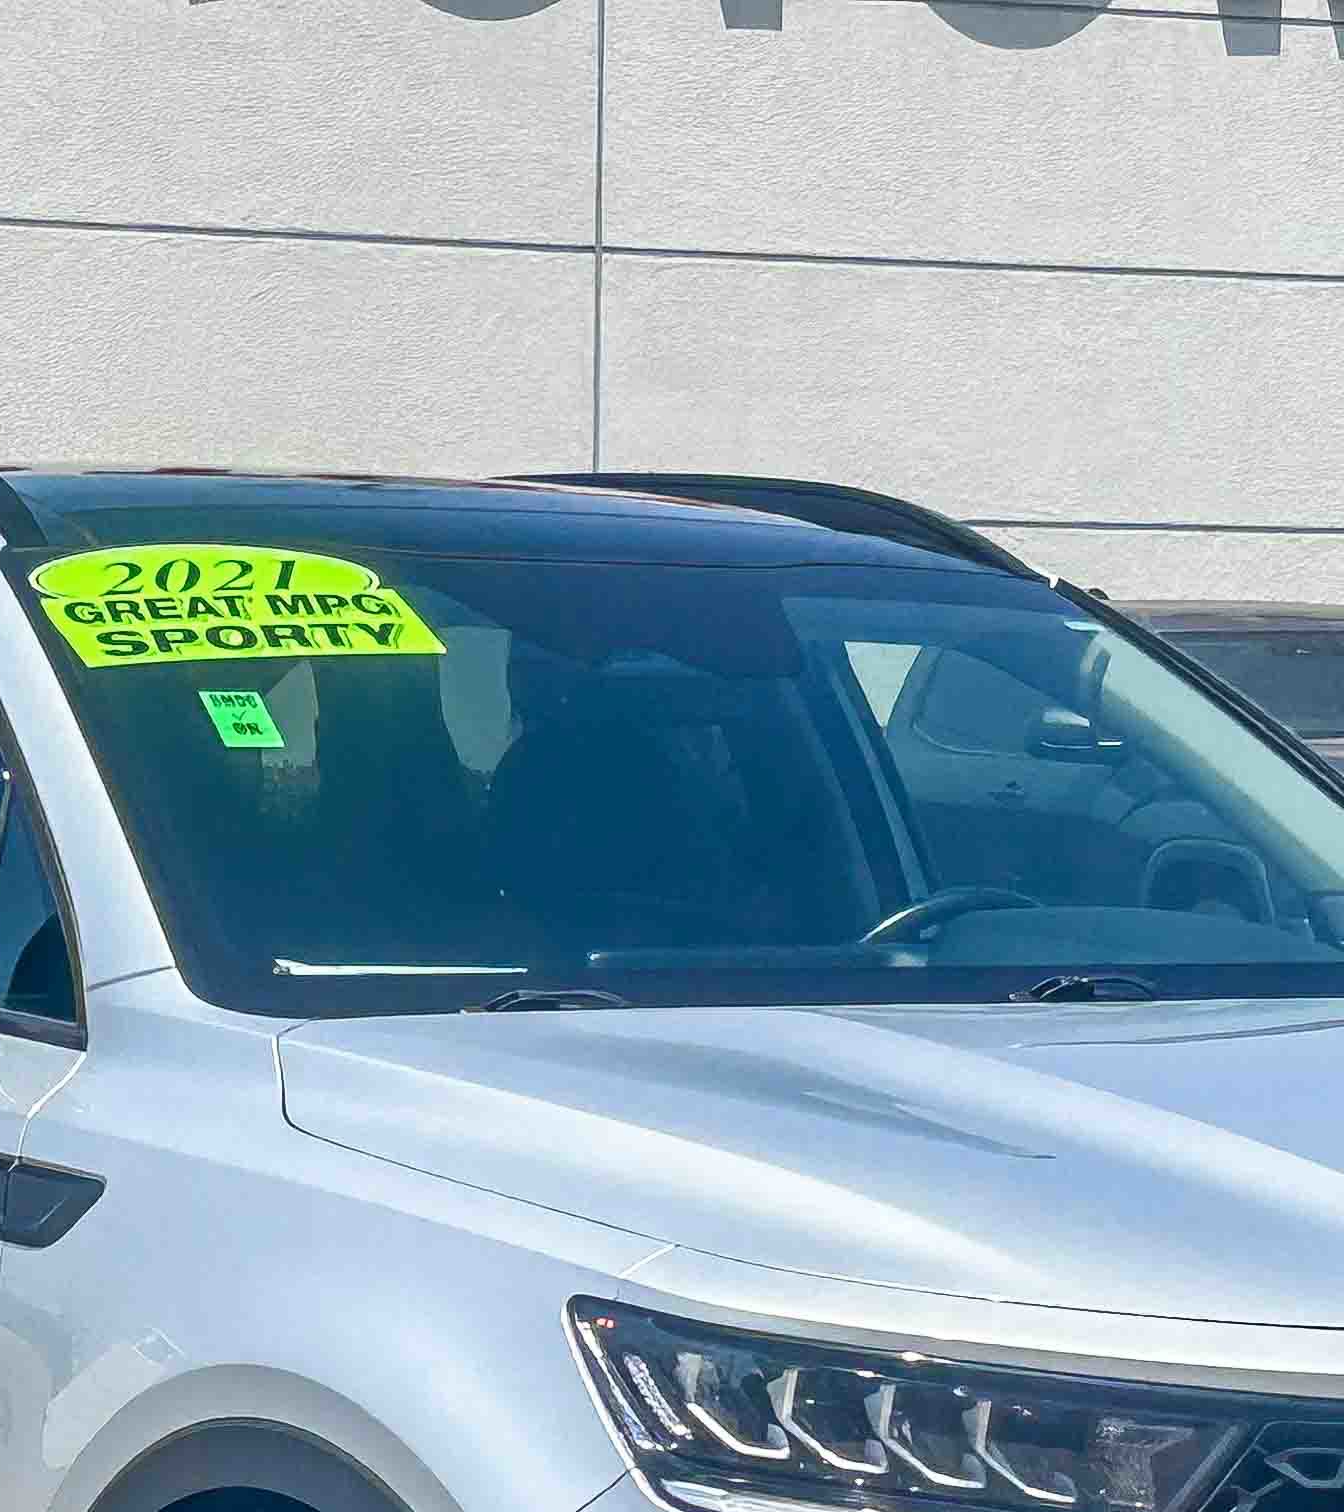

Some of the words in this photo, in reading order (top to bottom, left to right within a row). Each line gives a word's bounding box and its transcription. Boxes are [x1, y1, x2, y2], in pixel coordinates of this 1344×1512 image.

[99, 559, 296, 597] 2021
[64, 595, 249, 626] GREAT
[268, 594, 399, 618] MPG
[96, 623, 402, 657] SPORTY
